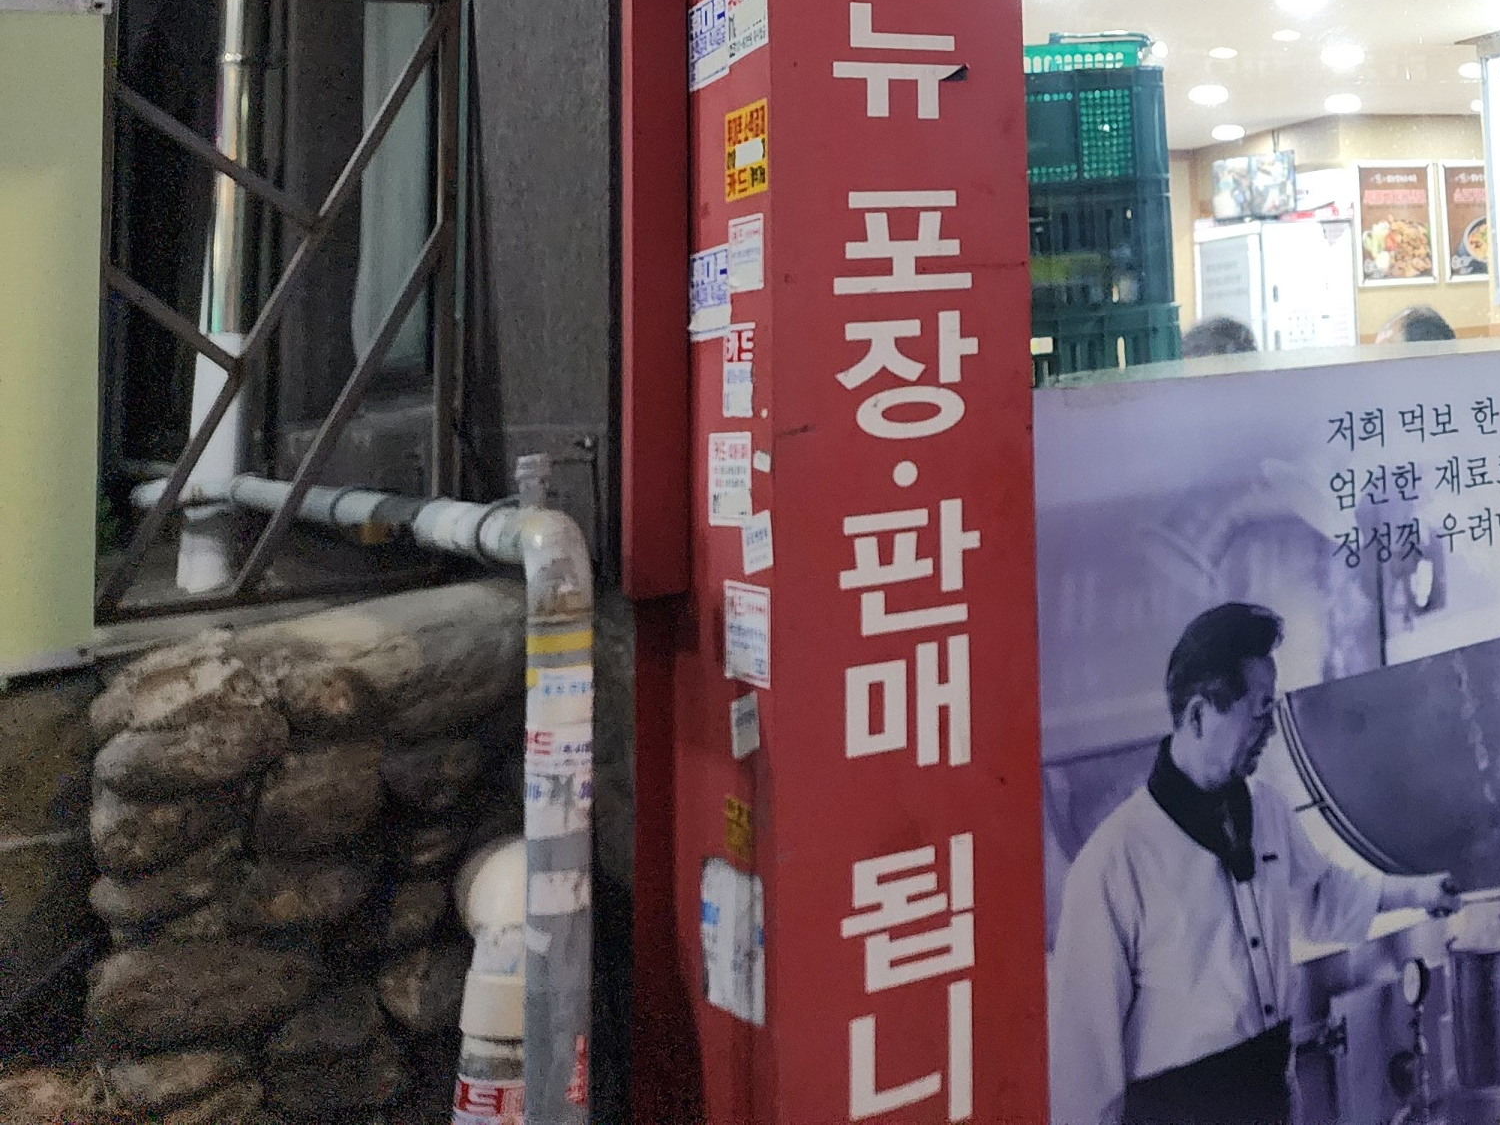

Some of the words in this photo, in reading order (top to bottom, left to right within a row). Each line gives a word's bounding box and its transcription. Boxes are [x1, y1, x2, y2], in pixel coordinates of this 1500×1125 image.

[1327, 410, 1385, 452] 저희
[1398, 403, 1459, 443] 먹보
[1329, 463, 1422, 511] 엄선한
[1332, 518, 1424, 569] 정성껏
